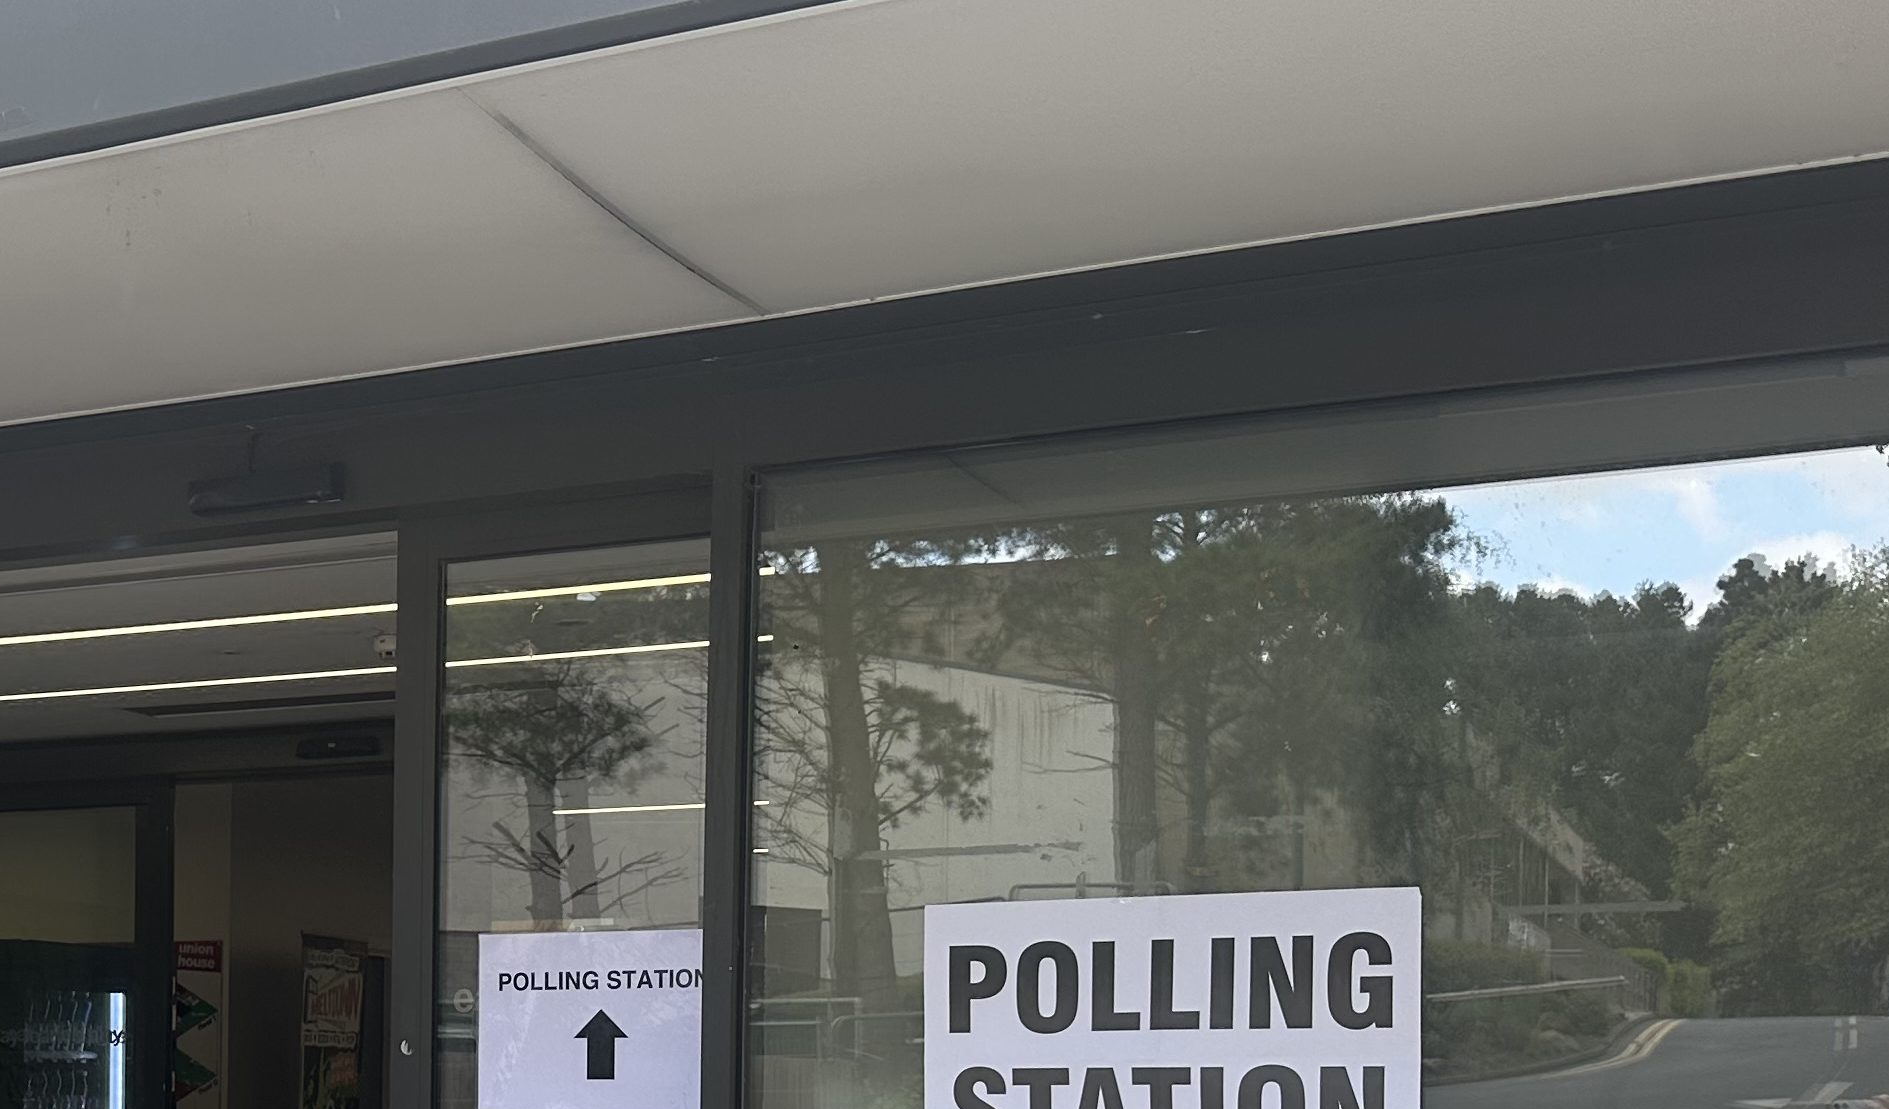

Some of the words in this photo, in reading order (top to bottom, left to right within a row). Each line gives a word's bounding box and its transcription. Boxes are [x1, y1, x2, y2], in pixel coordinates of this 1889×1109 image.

[179, 944, 214, 955] union
[177, 954, 215, 969] house
[499, 970, 599, 991] POLLING
[948, 932, 1393, 1034] POLLING
